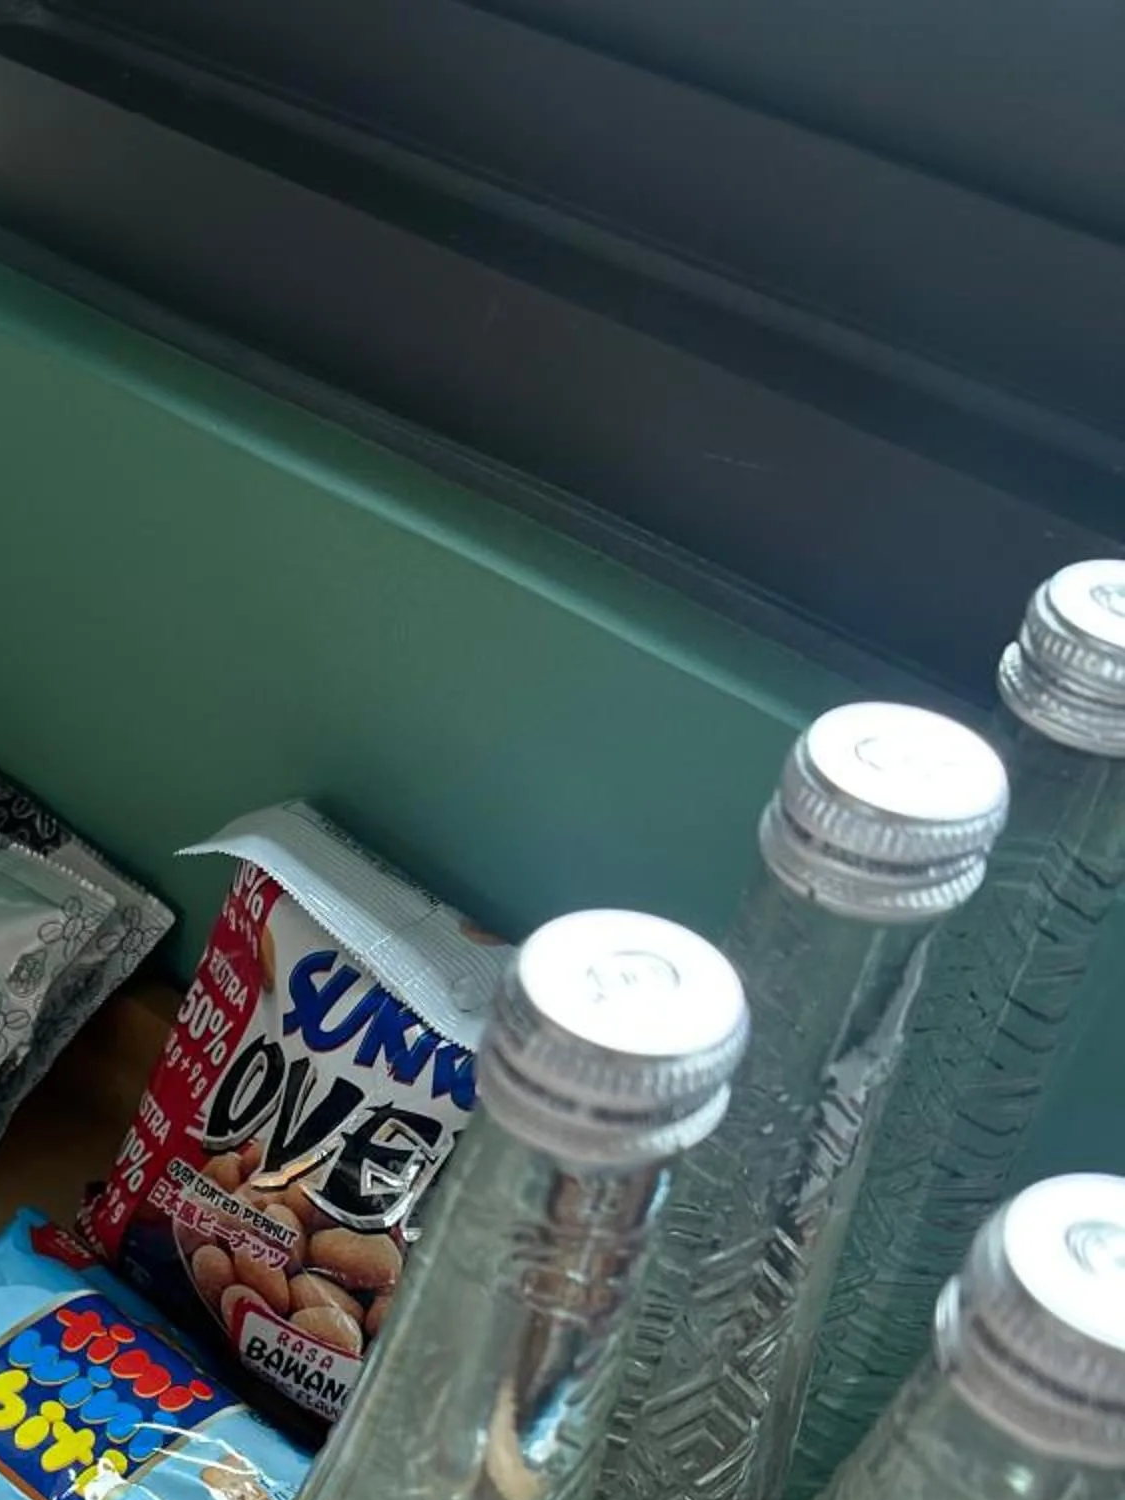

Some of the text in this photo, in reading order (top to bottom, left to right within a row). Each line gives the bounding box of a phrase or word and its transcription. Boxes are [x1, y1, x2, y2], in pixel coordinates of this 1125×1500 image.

[177, 978, 234, 1067] 50%
[203, 1034, 450, 1233] OVE
[168, 1158, 299, 1248] OVEN COATED PEANUT
[245, 1335, 350, 1410] BAWAN
[276, 1330, 334, 1372] RASA
